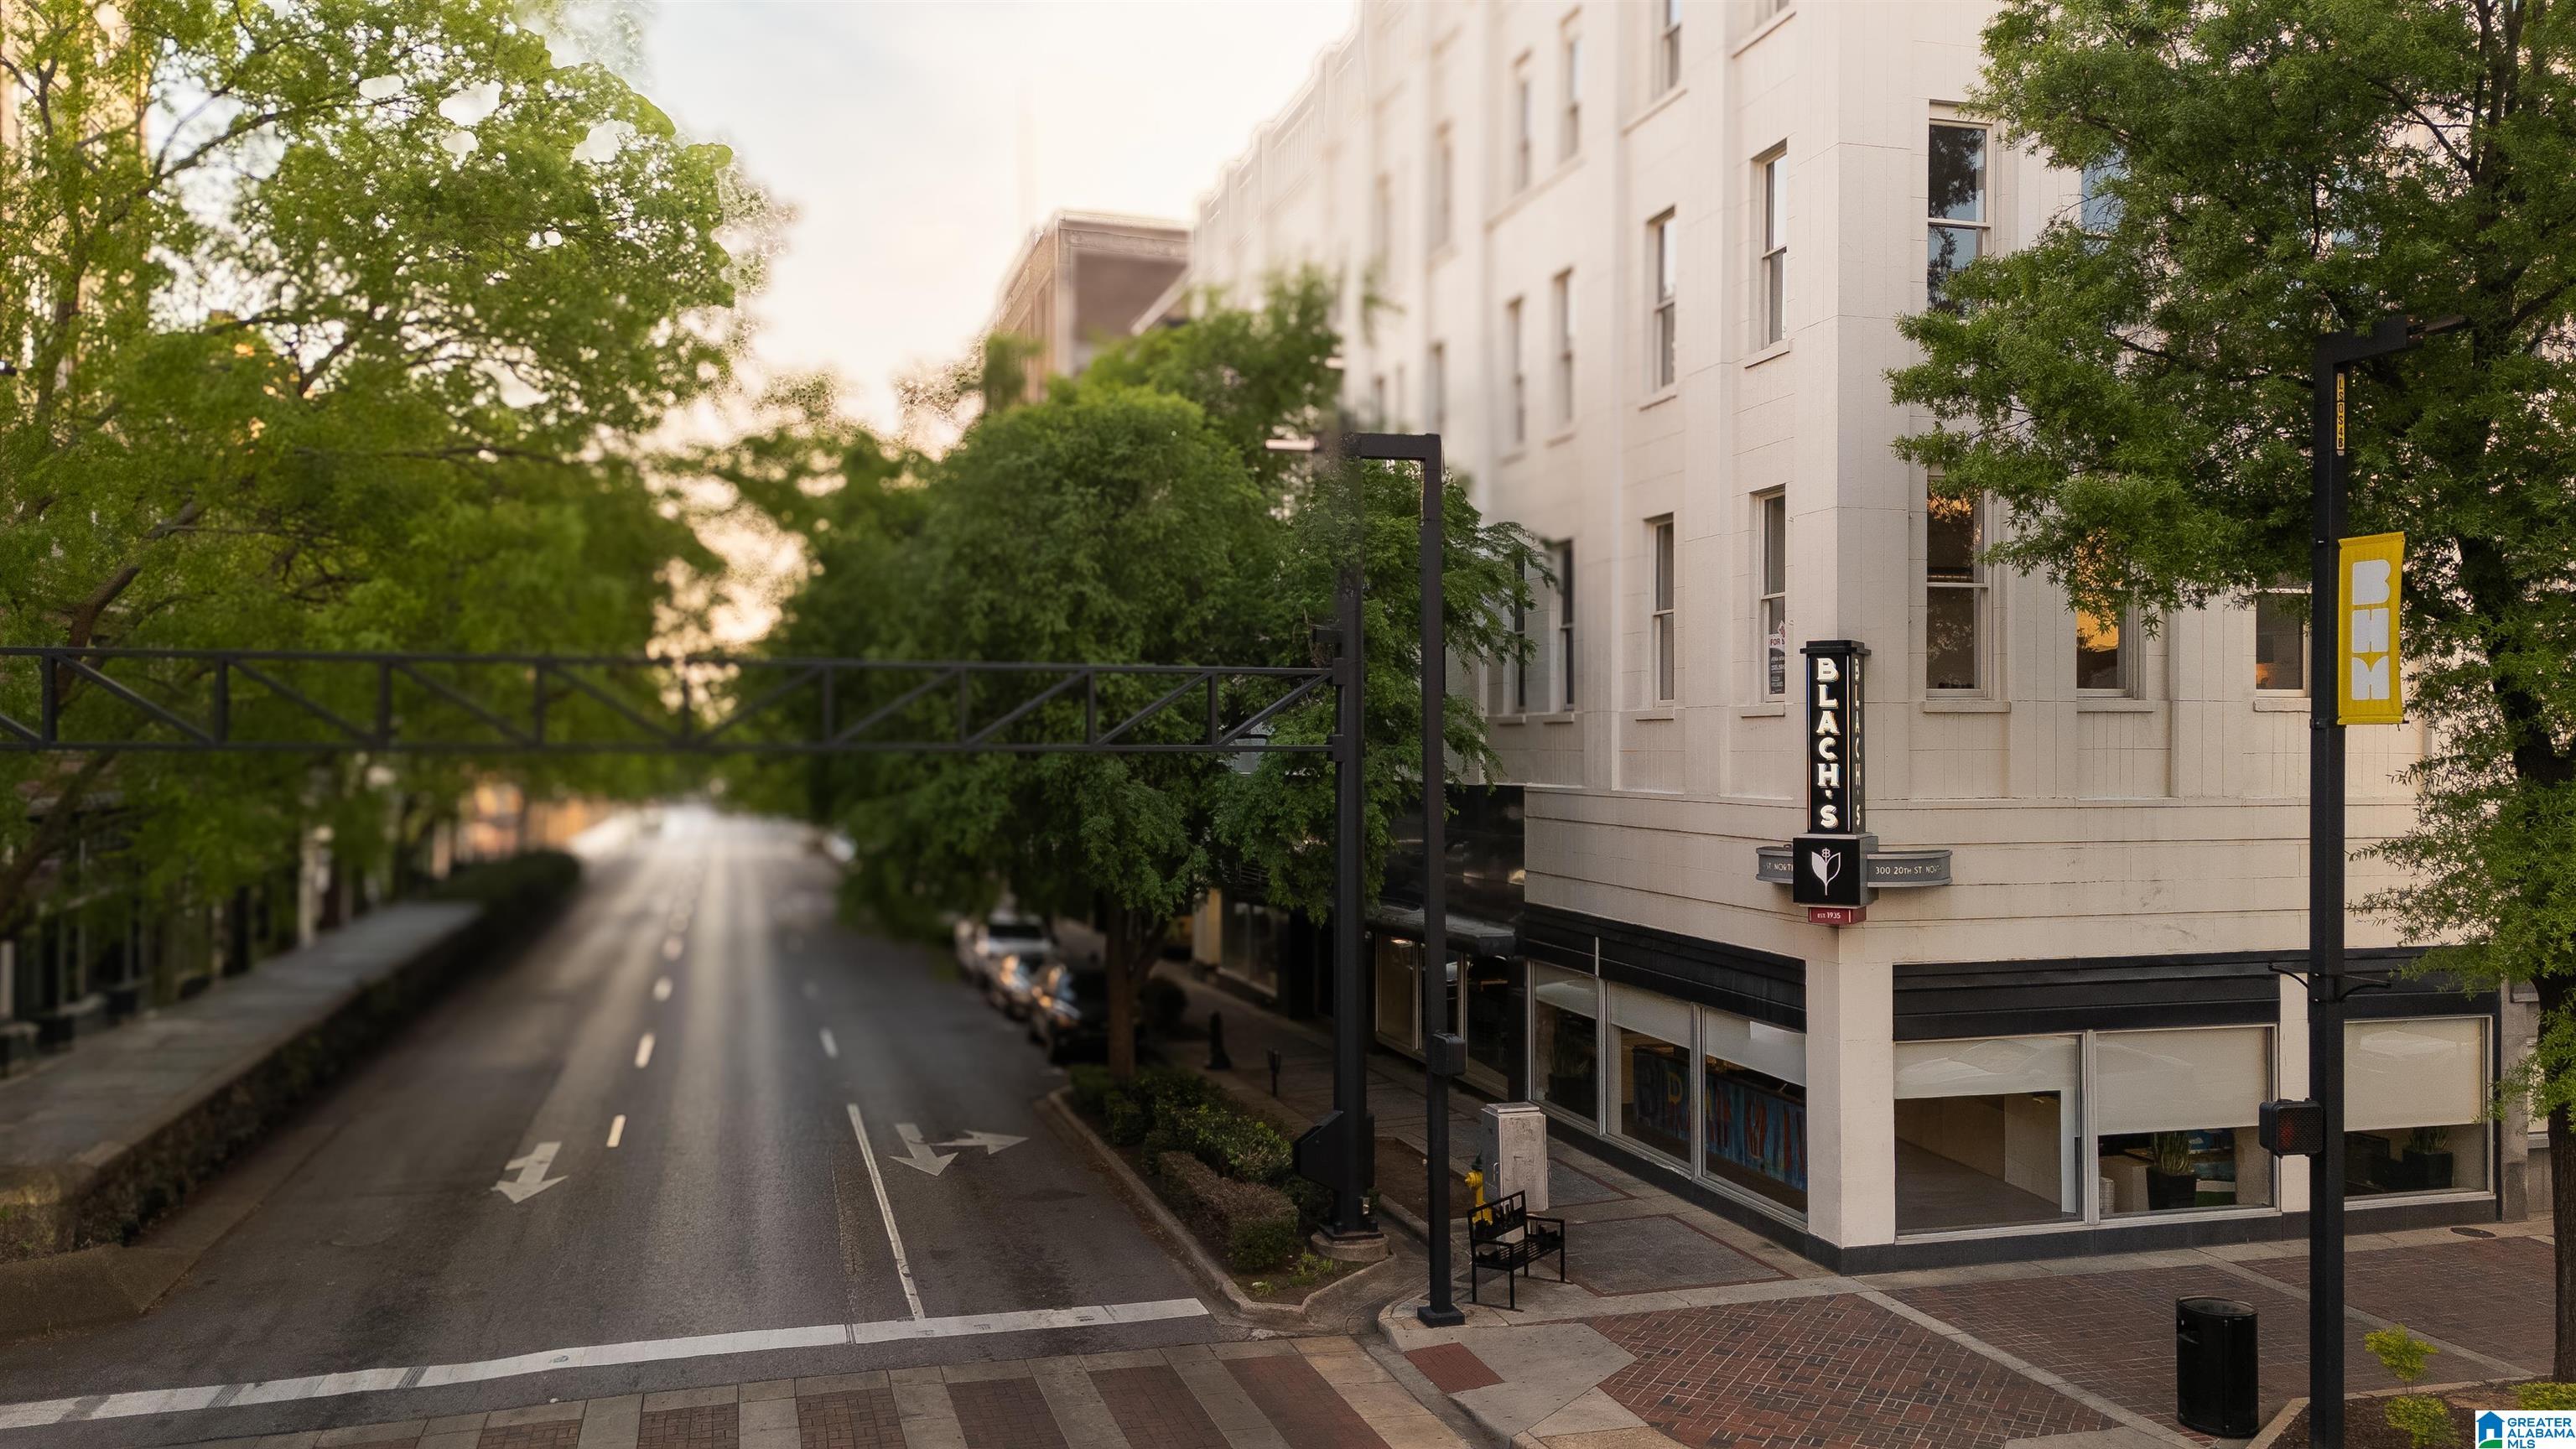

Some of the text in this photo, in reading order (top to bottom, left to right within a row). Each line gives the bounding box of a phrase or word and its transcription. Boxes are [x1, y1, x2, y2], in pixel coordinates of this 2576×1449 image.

[1817, 657, 1841, 829] BLACH'S
[1876, 866, 1891, 875] 300
[1893, 866, 1912, 875] 20TH
